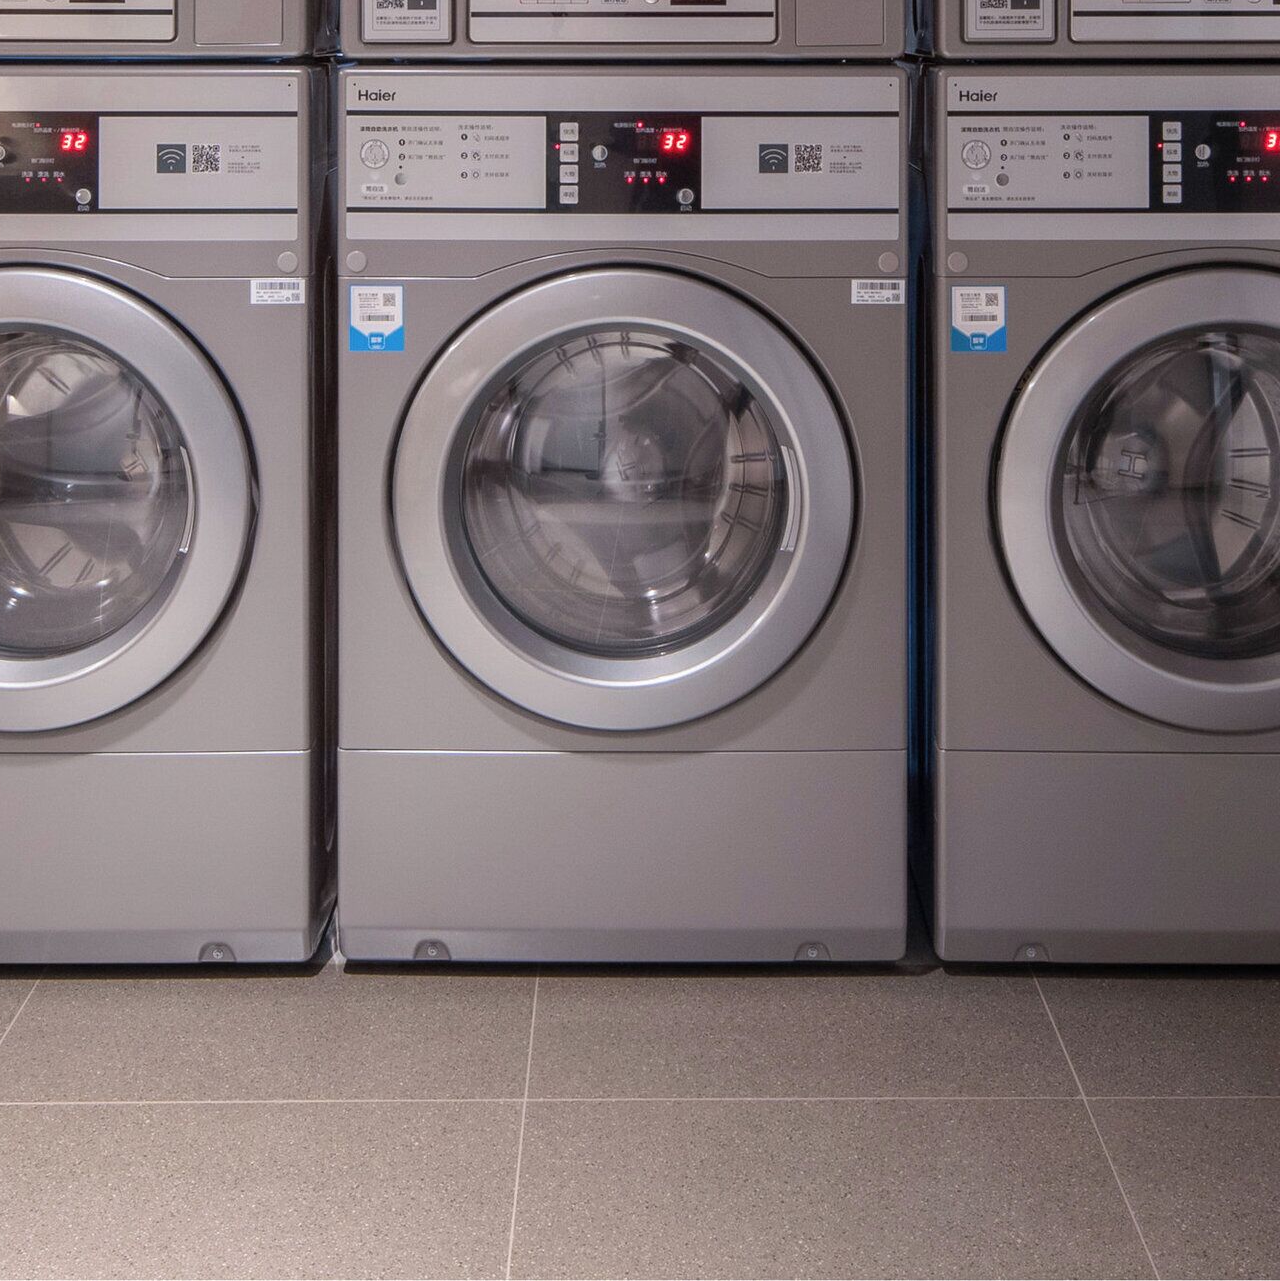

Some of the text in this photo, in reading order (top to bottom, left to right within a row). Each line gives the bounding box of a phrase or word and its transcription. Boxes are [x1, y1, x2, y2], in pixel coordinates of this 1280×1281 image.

[358, 89, 396, 101] Haier
[959, 90, 998, 102] Haier
[62, 134, 86, 149] 32
[664, 134, 687, 149] 32
